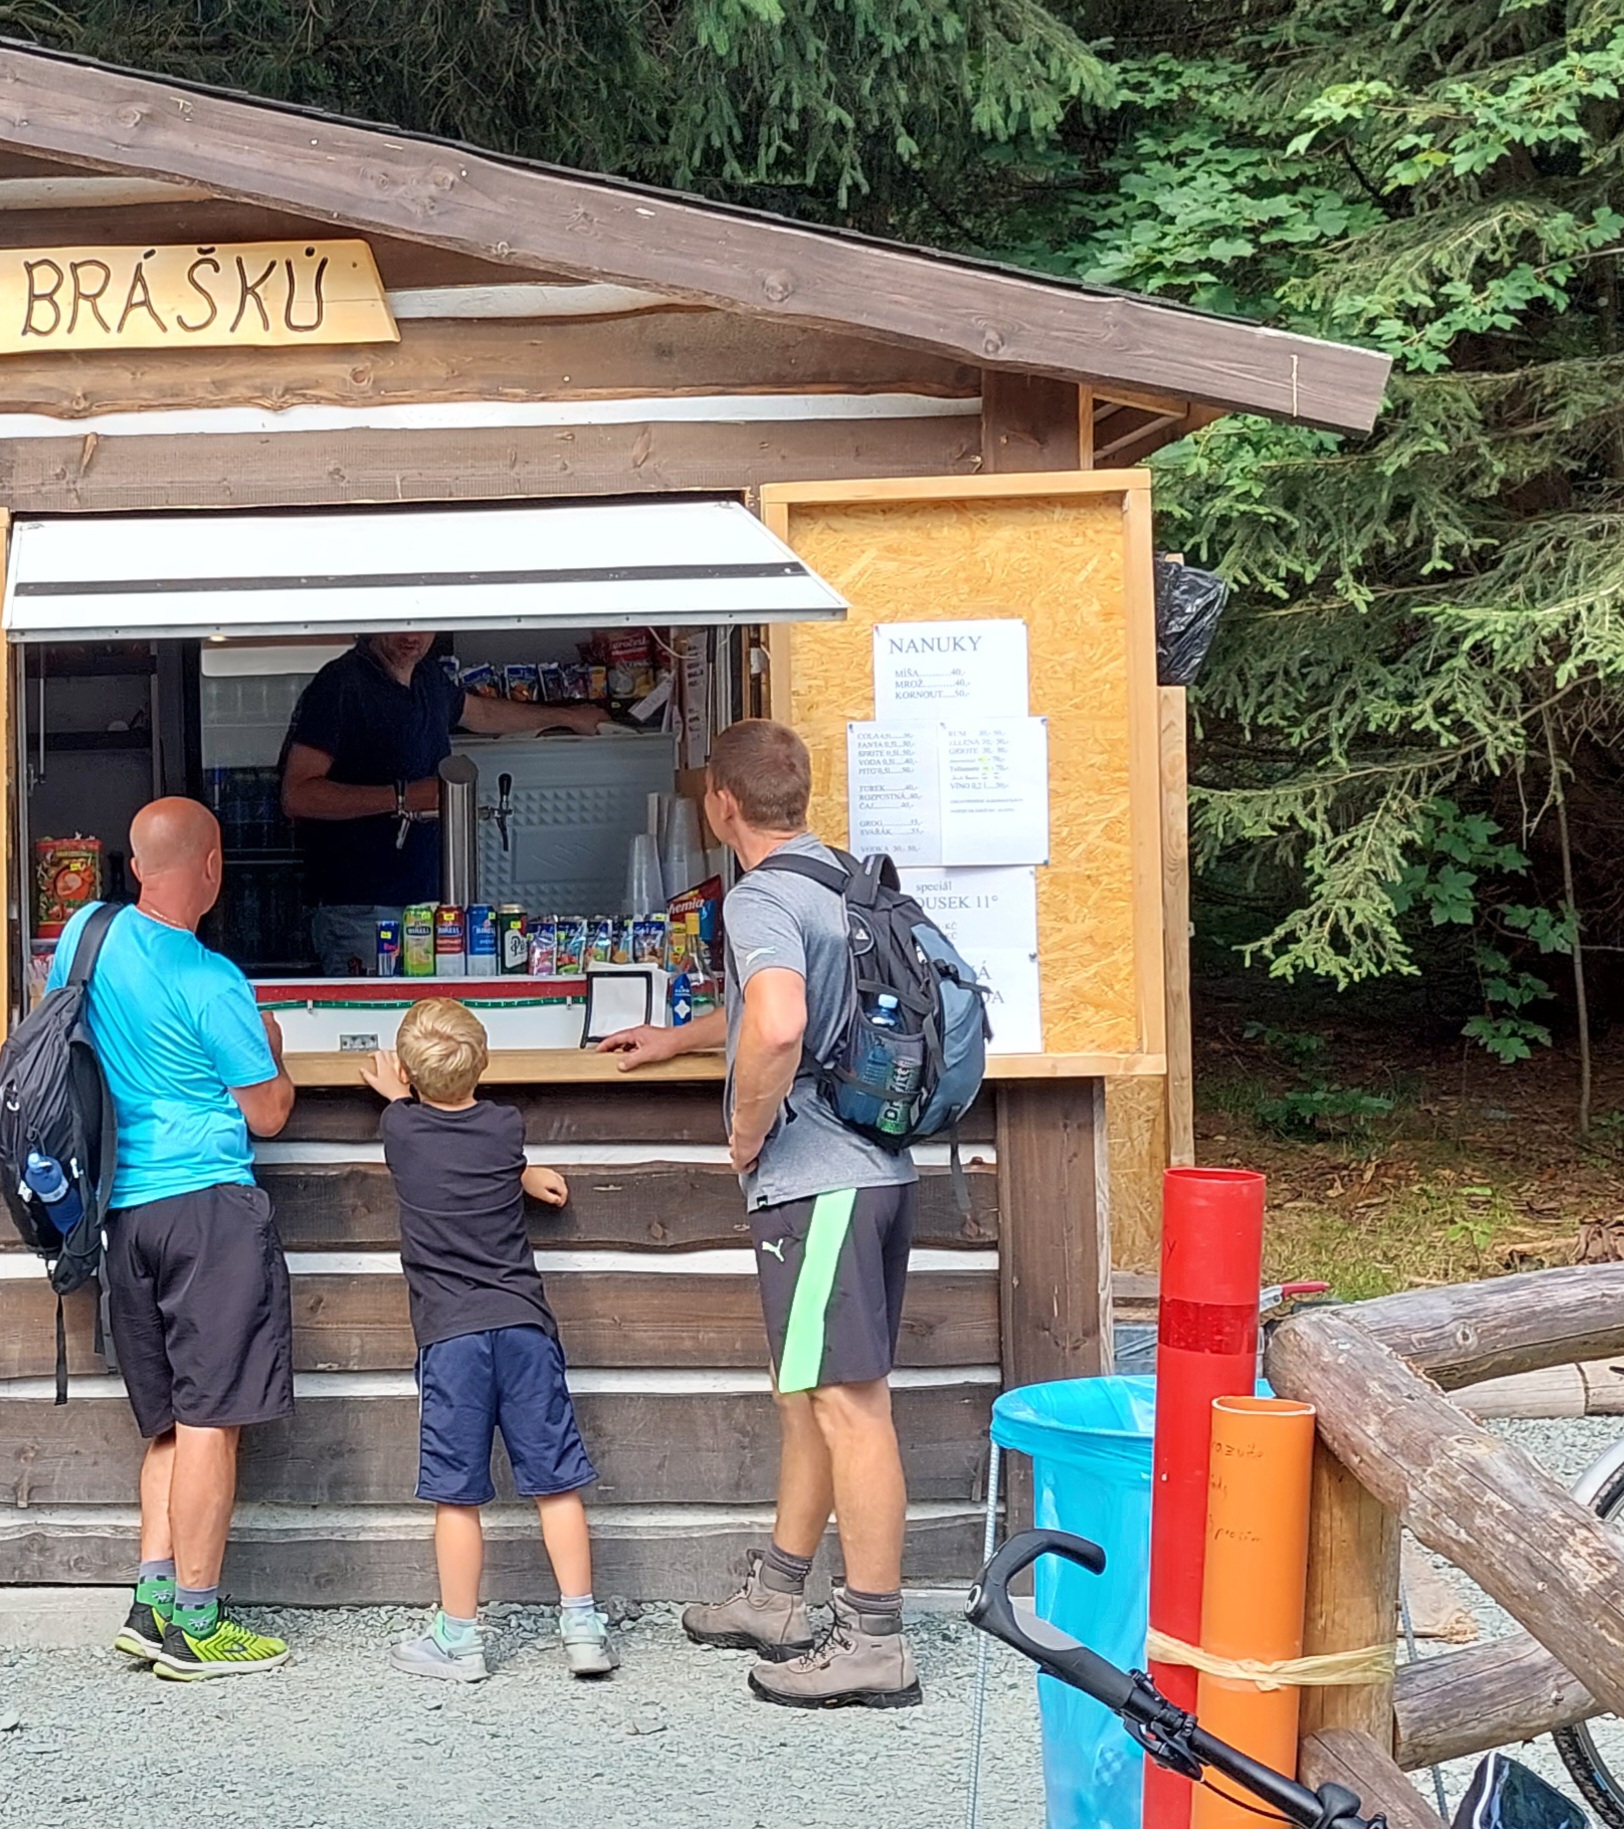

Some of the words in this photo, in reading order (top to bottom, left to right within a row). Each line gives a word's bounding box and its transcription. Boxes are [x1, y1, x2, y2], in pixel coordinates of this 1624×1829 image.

[22, 246, 330, 336] BRÁŠKŮ
[889, 636, 982, 654] NANUKY
[895, 690, 943, 699] KORNOUT
[916, 880, 952, 894] speciál
[916, 896, 972, 910] OUSEK
